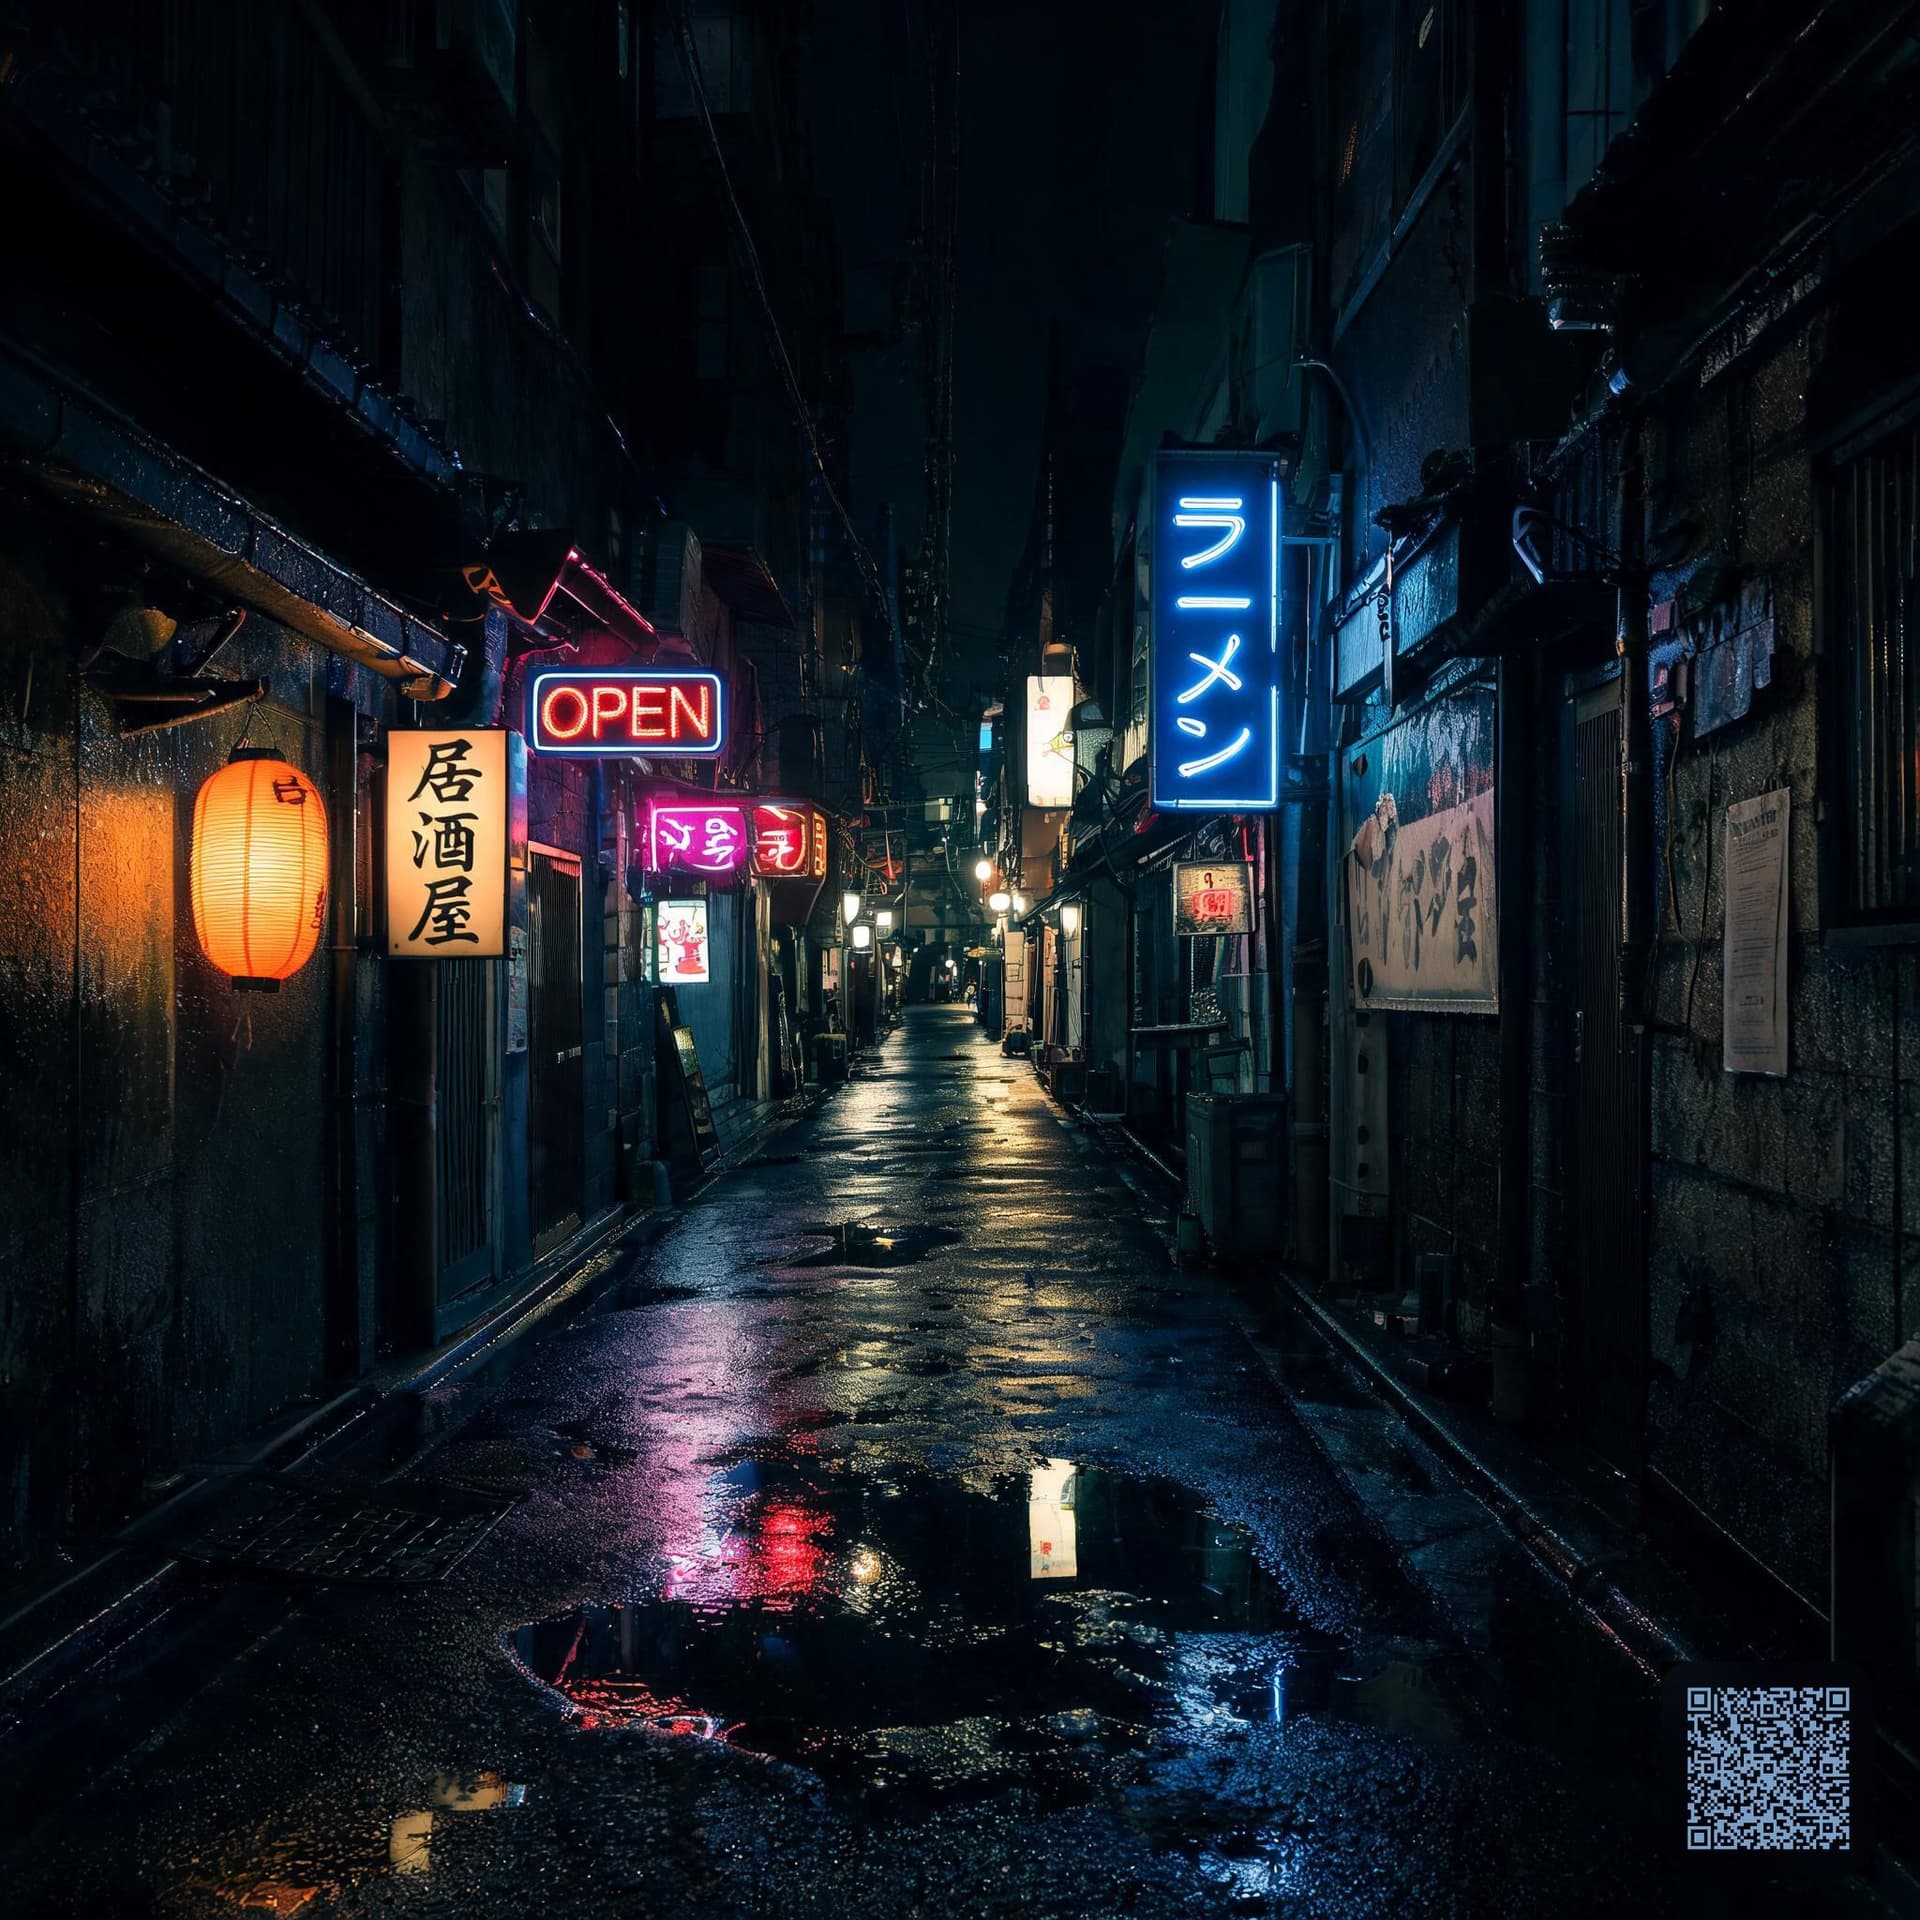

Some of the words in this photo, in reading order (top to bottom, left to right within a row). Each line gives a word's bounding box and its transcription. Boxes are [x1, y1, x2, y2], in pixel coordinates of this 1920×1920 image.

[542, 686, 708, 738] OPEN
[1173, 497, 1251, 777] ラーメン
[408, 739, 482, 945] 居酒屋
